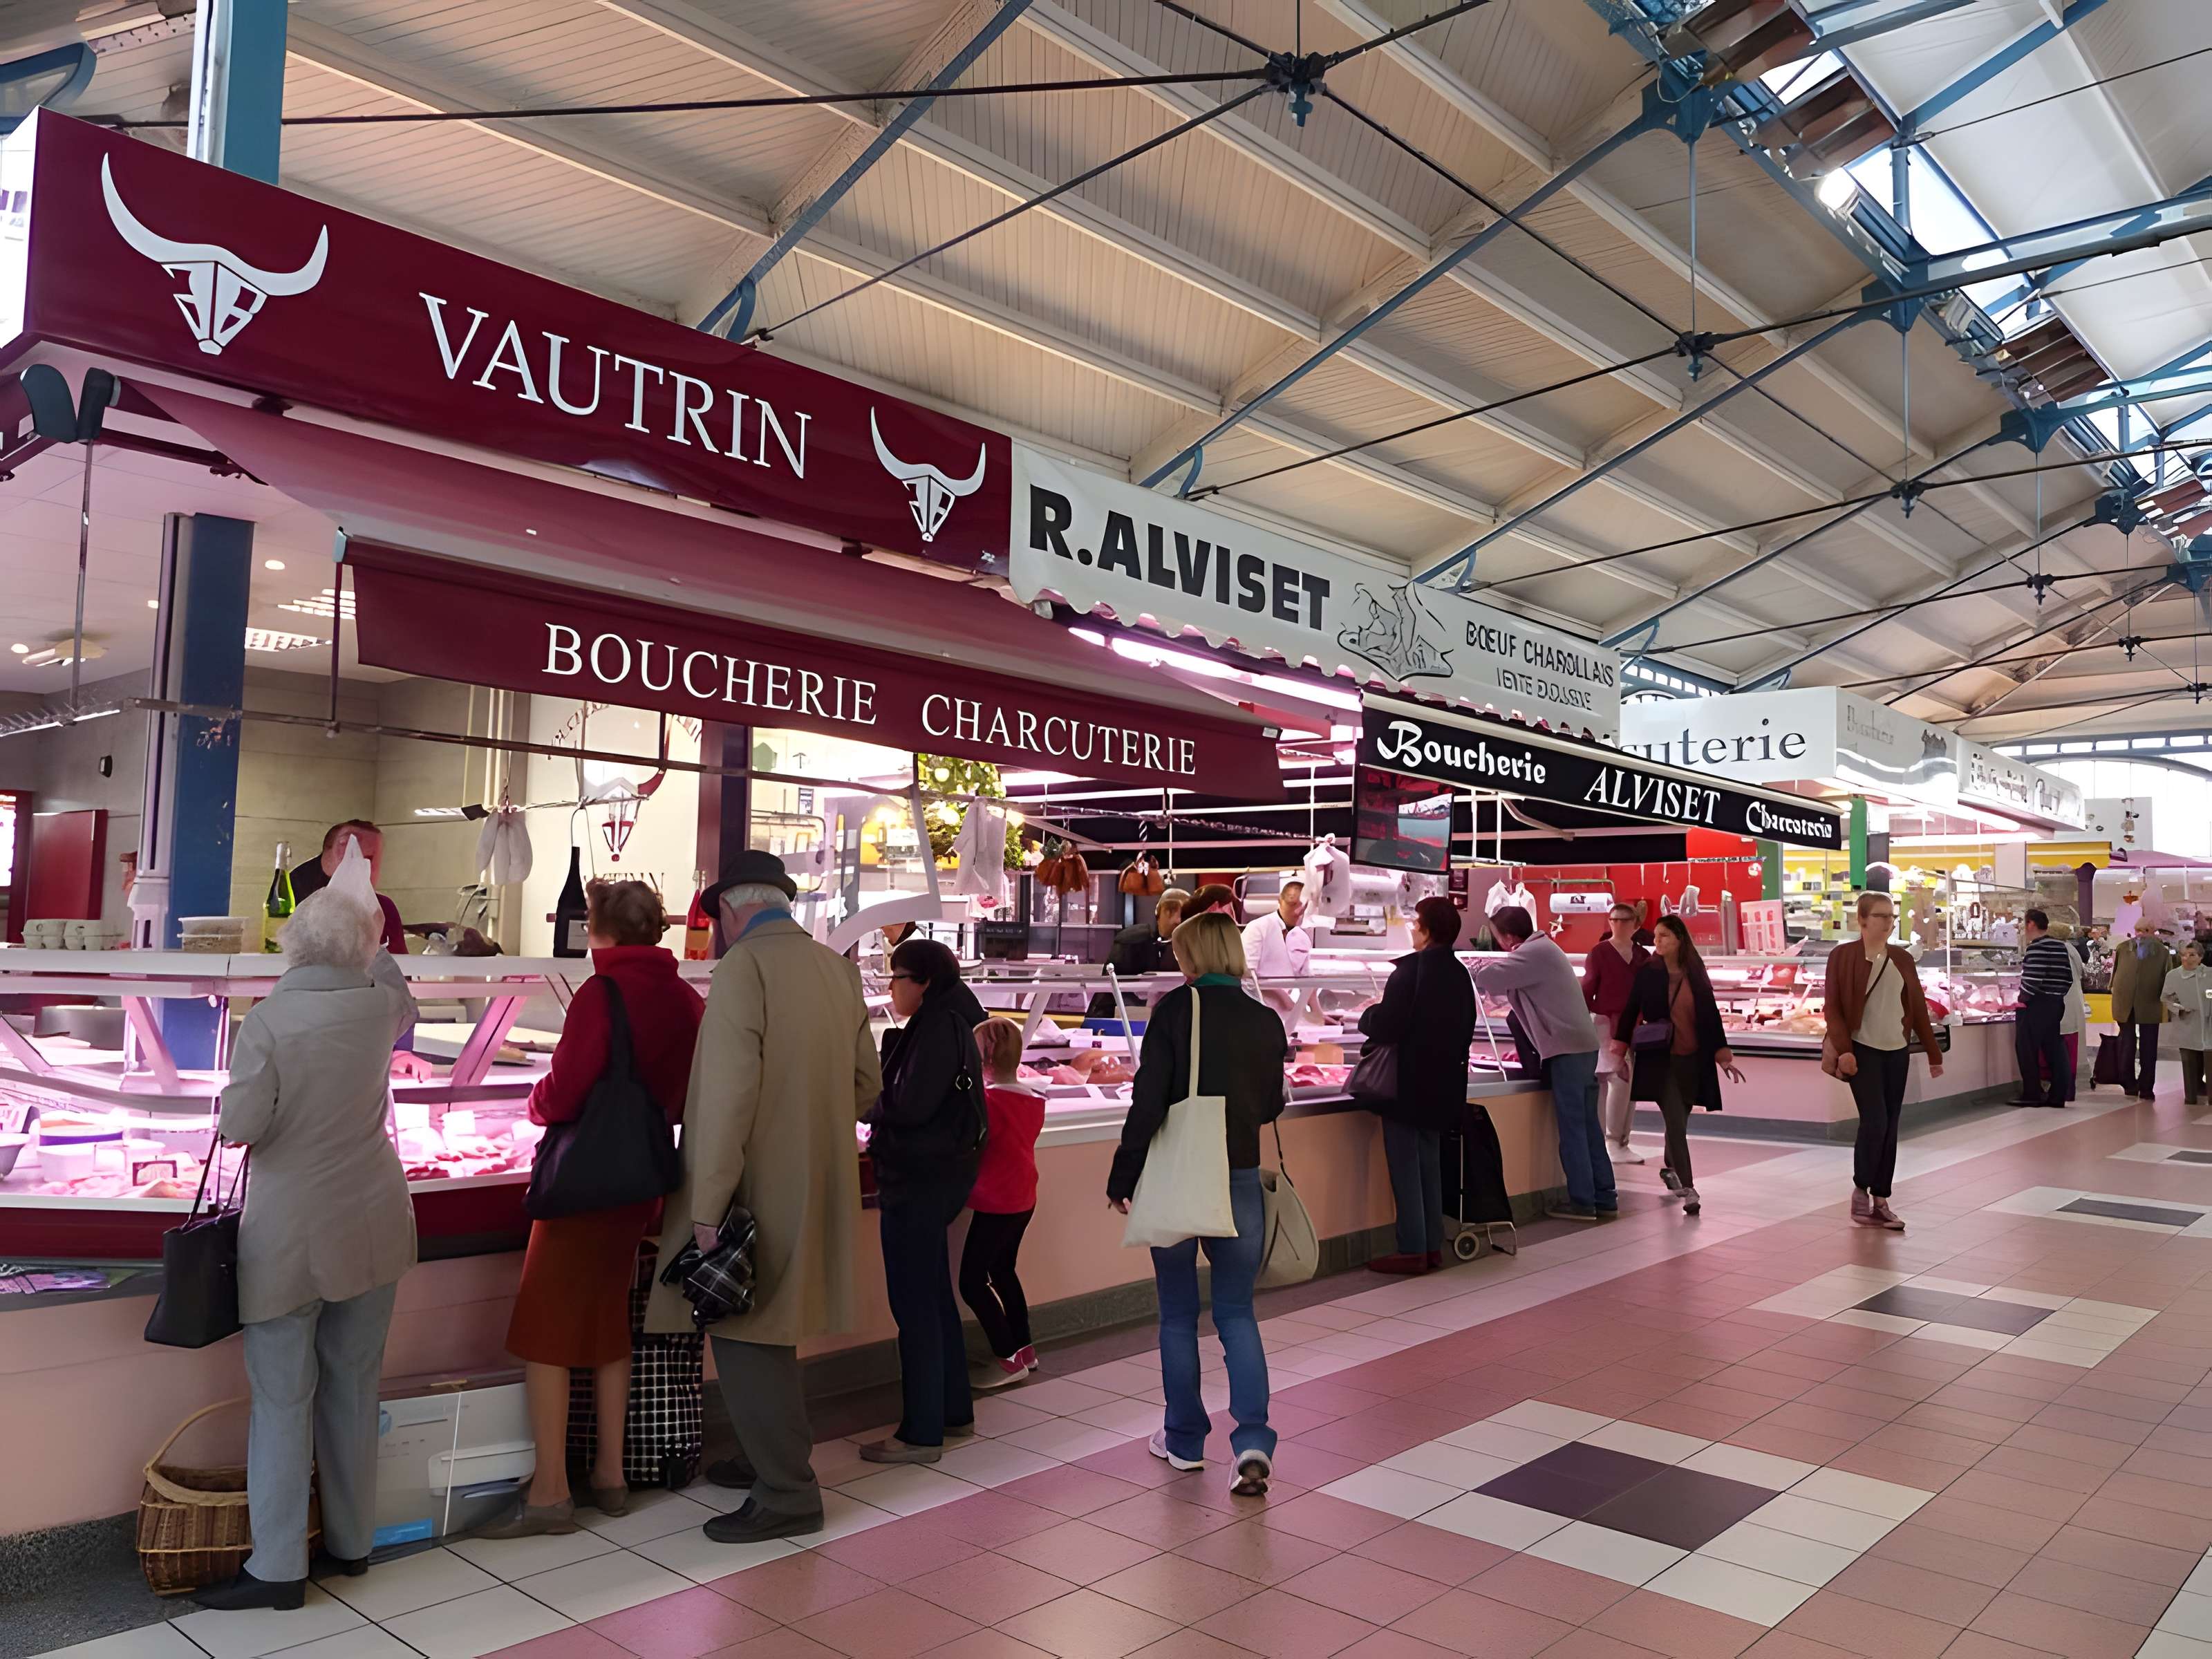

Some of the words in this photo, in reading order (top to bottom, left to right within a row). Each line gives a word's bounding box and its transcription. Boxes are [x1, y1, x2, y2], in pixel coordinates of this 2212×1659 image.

[419, 292, 812, 479] VAUTRIN
[1029, 484, 1331, 630] R.ALVISET
[542, 622, 877, 725] BOUCHERIE
[921, 694, 1196, 775] CHARCUTERIE
[1377, 721, 1546, 784] Boucherie
[1584, 767, 1721, 824] ALVISET
